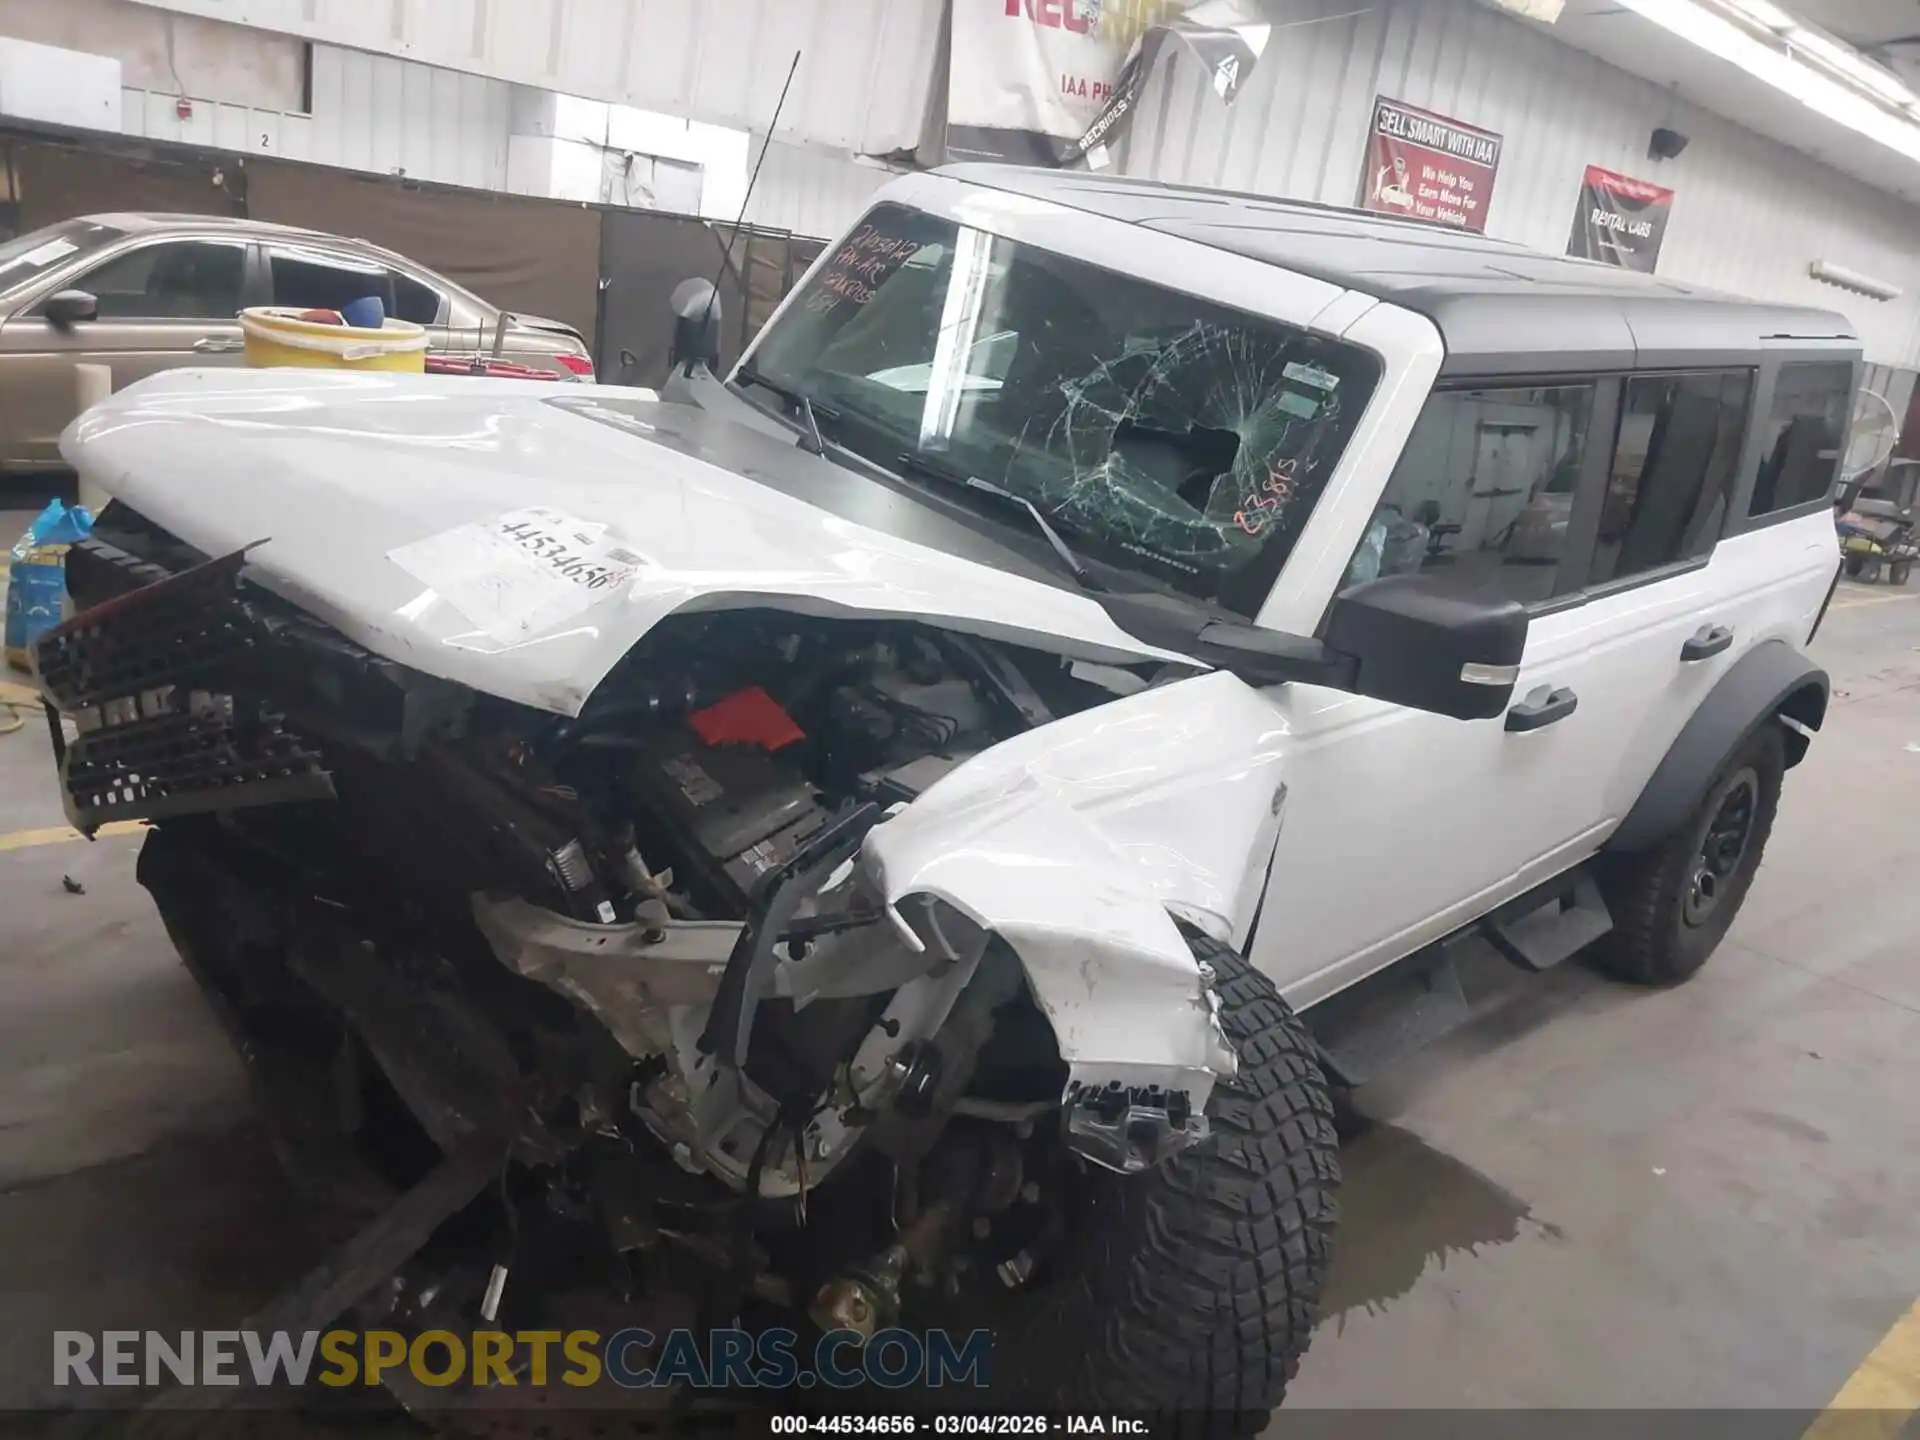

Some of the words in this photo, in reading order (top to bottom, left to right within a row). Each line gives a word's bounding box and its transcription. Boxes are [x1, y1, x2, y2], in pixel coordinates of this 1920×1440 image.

[1062, 73, 1087, 98] IAA
[262, 133, 269, 147] 2
[1380, 109, 1406, 135] SELL
[1408, 119, 1447, 148] SMART
[1448, 130, 1475, 156] WITH
[1475, 138, 1494, 163] IAA
[1460, 175, 1474, 192] You
[1416, 200, 1435, 217] Your
[1590, 208, 1625, 232] RENTAL
[501, 522, 608, 590] 44534656
